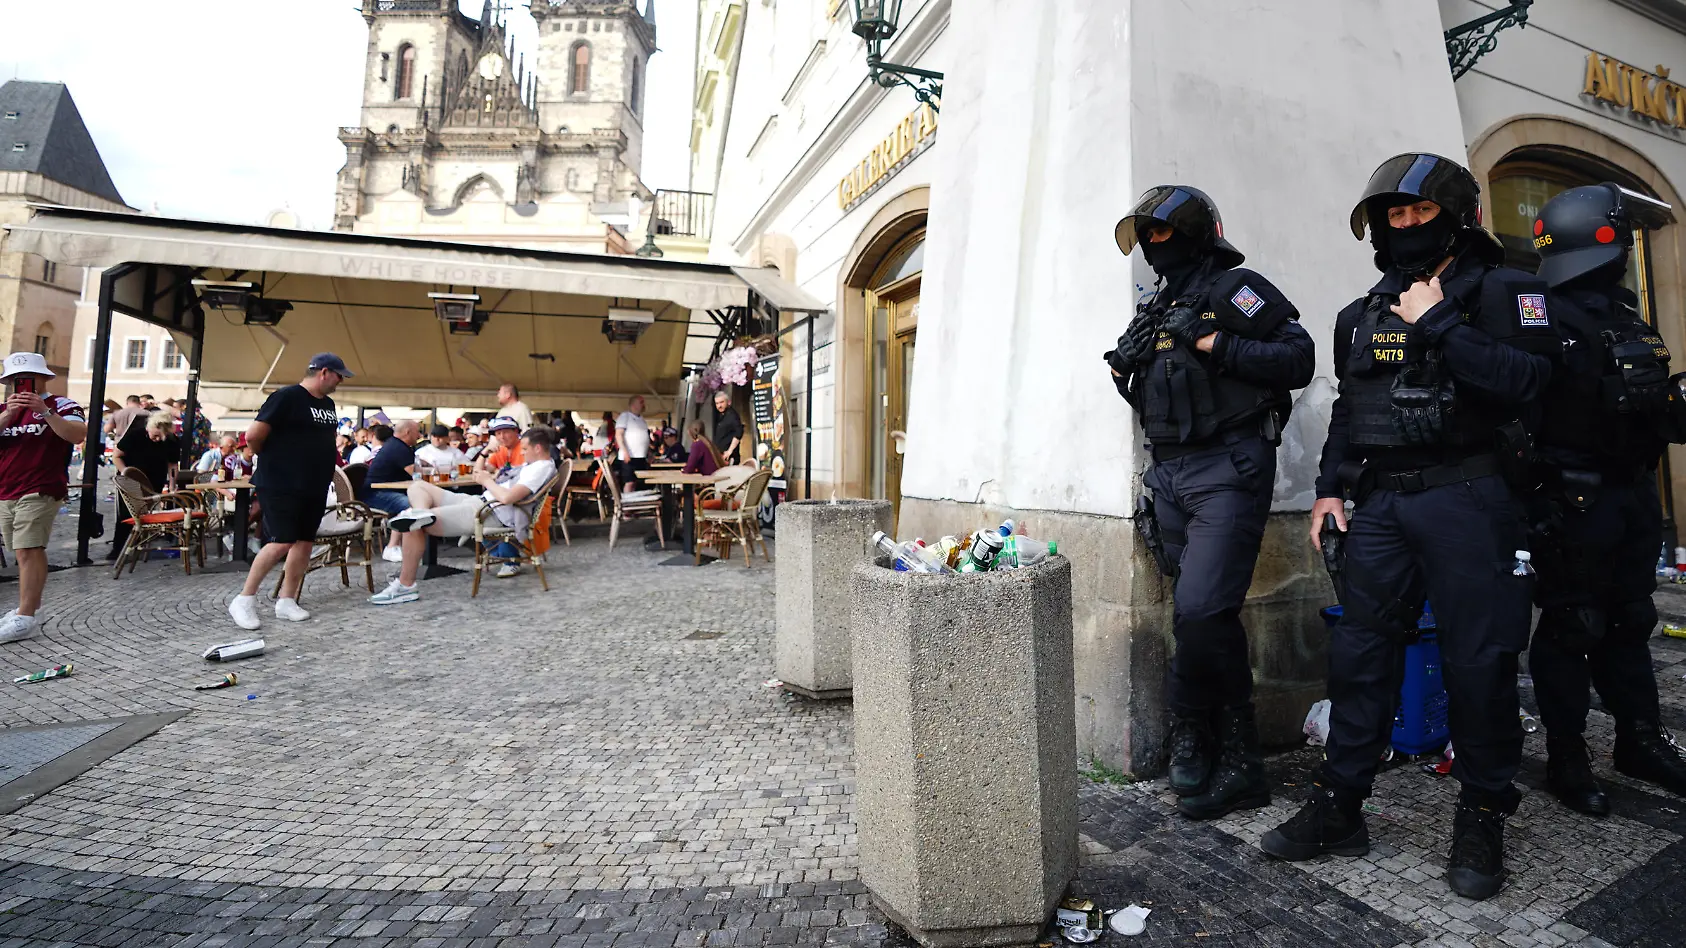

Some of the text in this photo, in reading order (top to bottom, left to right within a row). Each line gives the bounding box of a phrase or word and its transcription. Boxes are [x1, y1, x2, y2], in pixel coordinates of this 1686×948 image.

[837, 111, 916, 210] GALERIE
[339, 256, 512, 286] WHITE HORSE
[1372, 333, 1407, 343] POLICIE
[310, 406, 337, 420] BOSS
